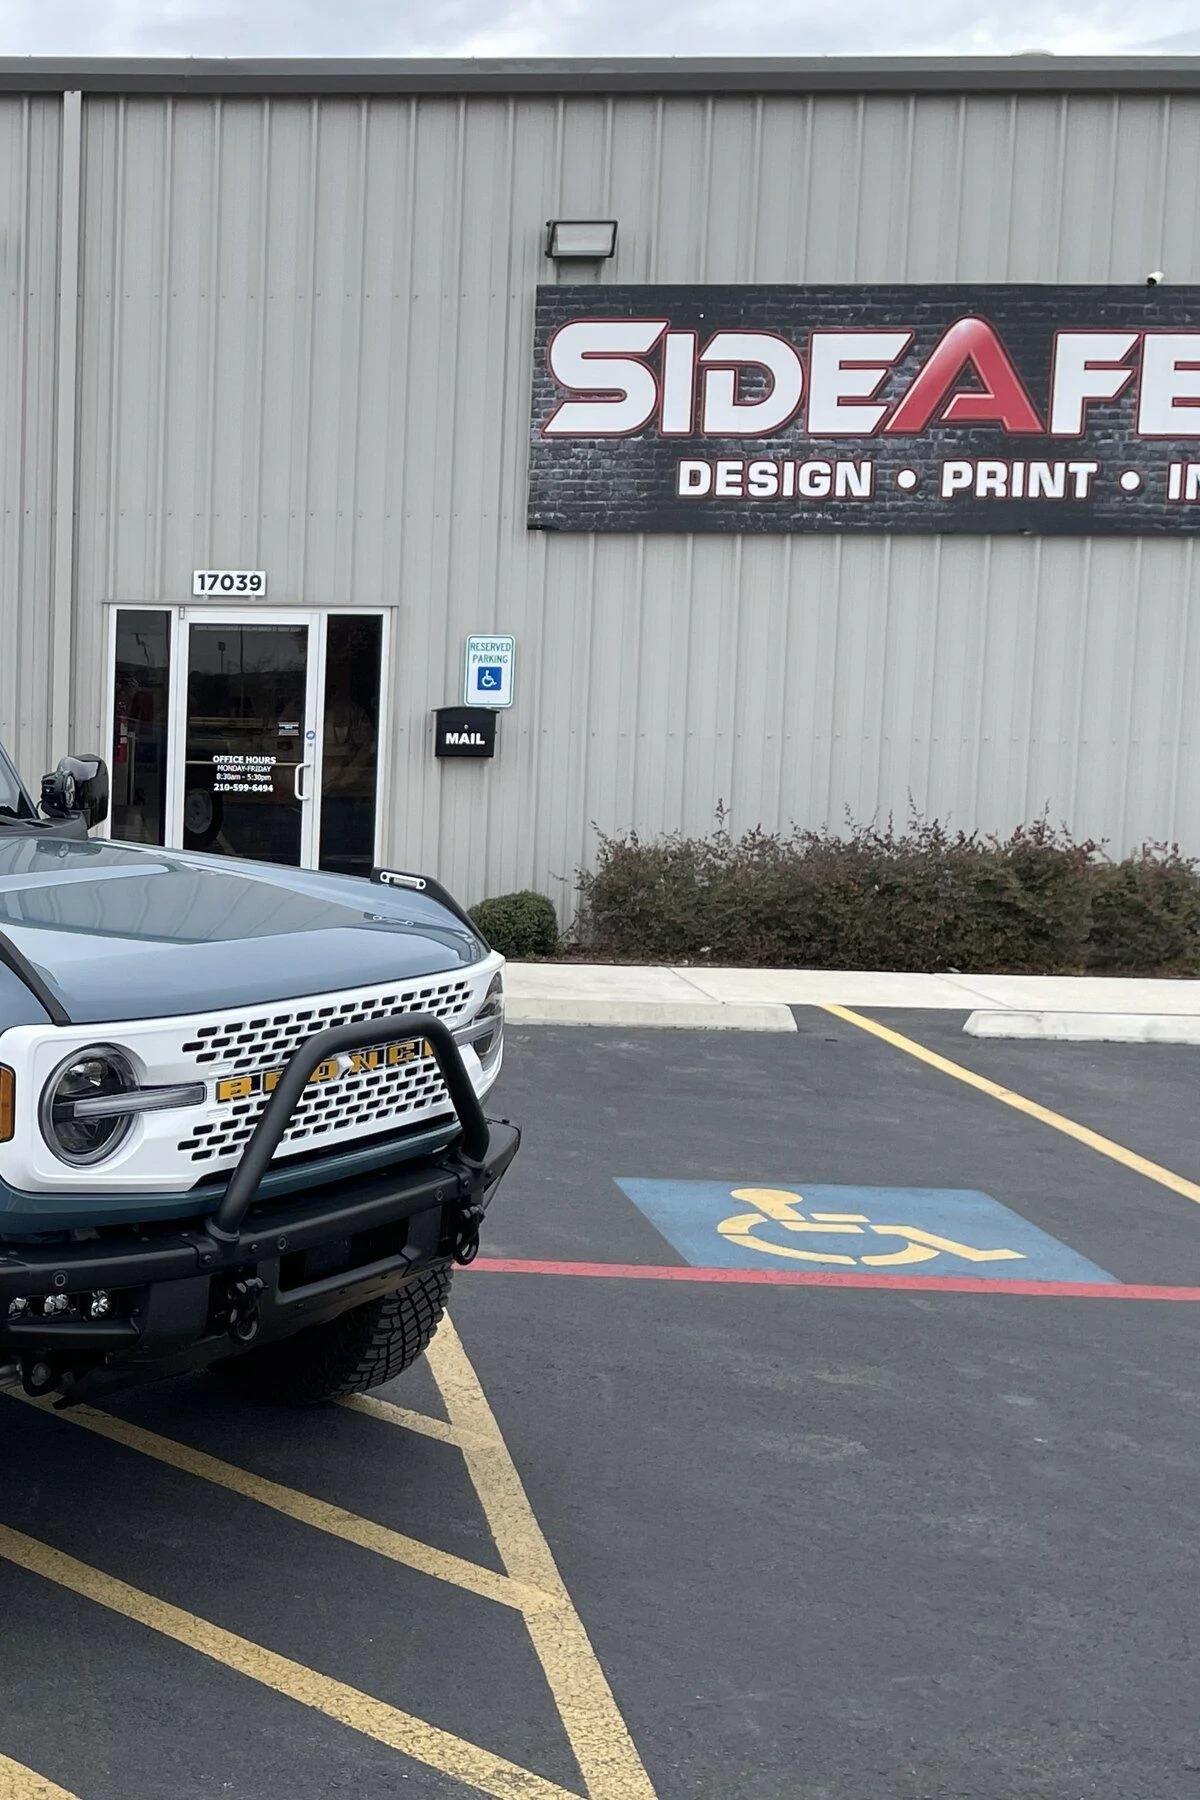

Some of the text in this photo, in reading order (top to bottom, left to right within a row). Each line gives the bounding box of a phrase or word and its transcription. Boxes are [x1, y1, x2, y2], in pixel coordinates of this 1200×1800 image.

[677, 460, 872, 498] DESIGN
[941, 461, 1098, 499] PRINT
[197, 573, 262, 592] 17039
[470, 642, 512, 652] RESERVED
[472, 654, 508, 664] PARKING
[445, 732, 486, 745] MAIL
[212, 755, 277, 765] OFFICE HOURS
[216, 764, 272, 773] MONDAY-FRIDAY
[246, 773, 272, 782] 5:30pm
[213, 783, 274, 792] 210-599-6494
